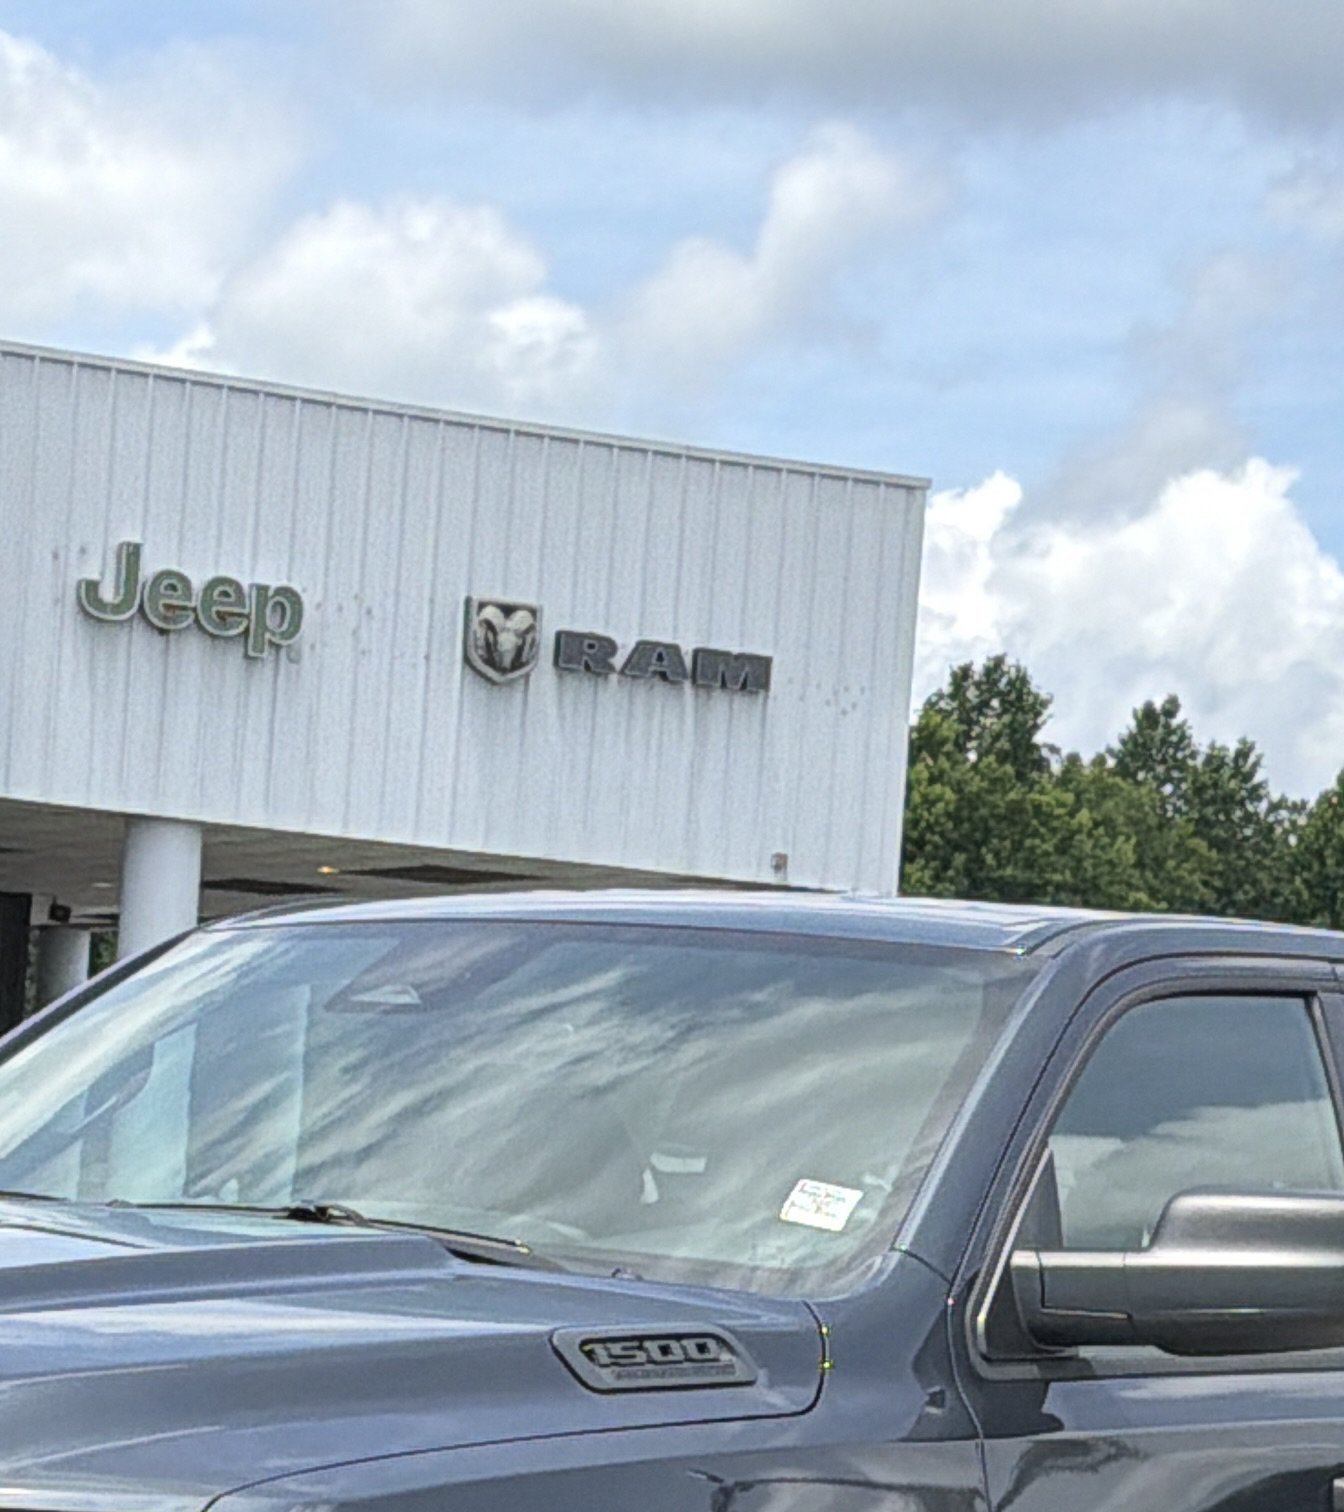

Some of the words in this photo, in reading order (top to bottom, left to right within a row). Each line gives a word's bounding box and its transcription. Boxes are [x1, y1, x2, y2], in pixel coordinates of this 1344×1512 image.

[77, 541, 304, 659] Jeep
[553, 629, 773, 695] RAM
[581, 1337, 723, 1368] 1500
